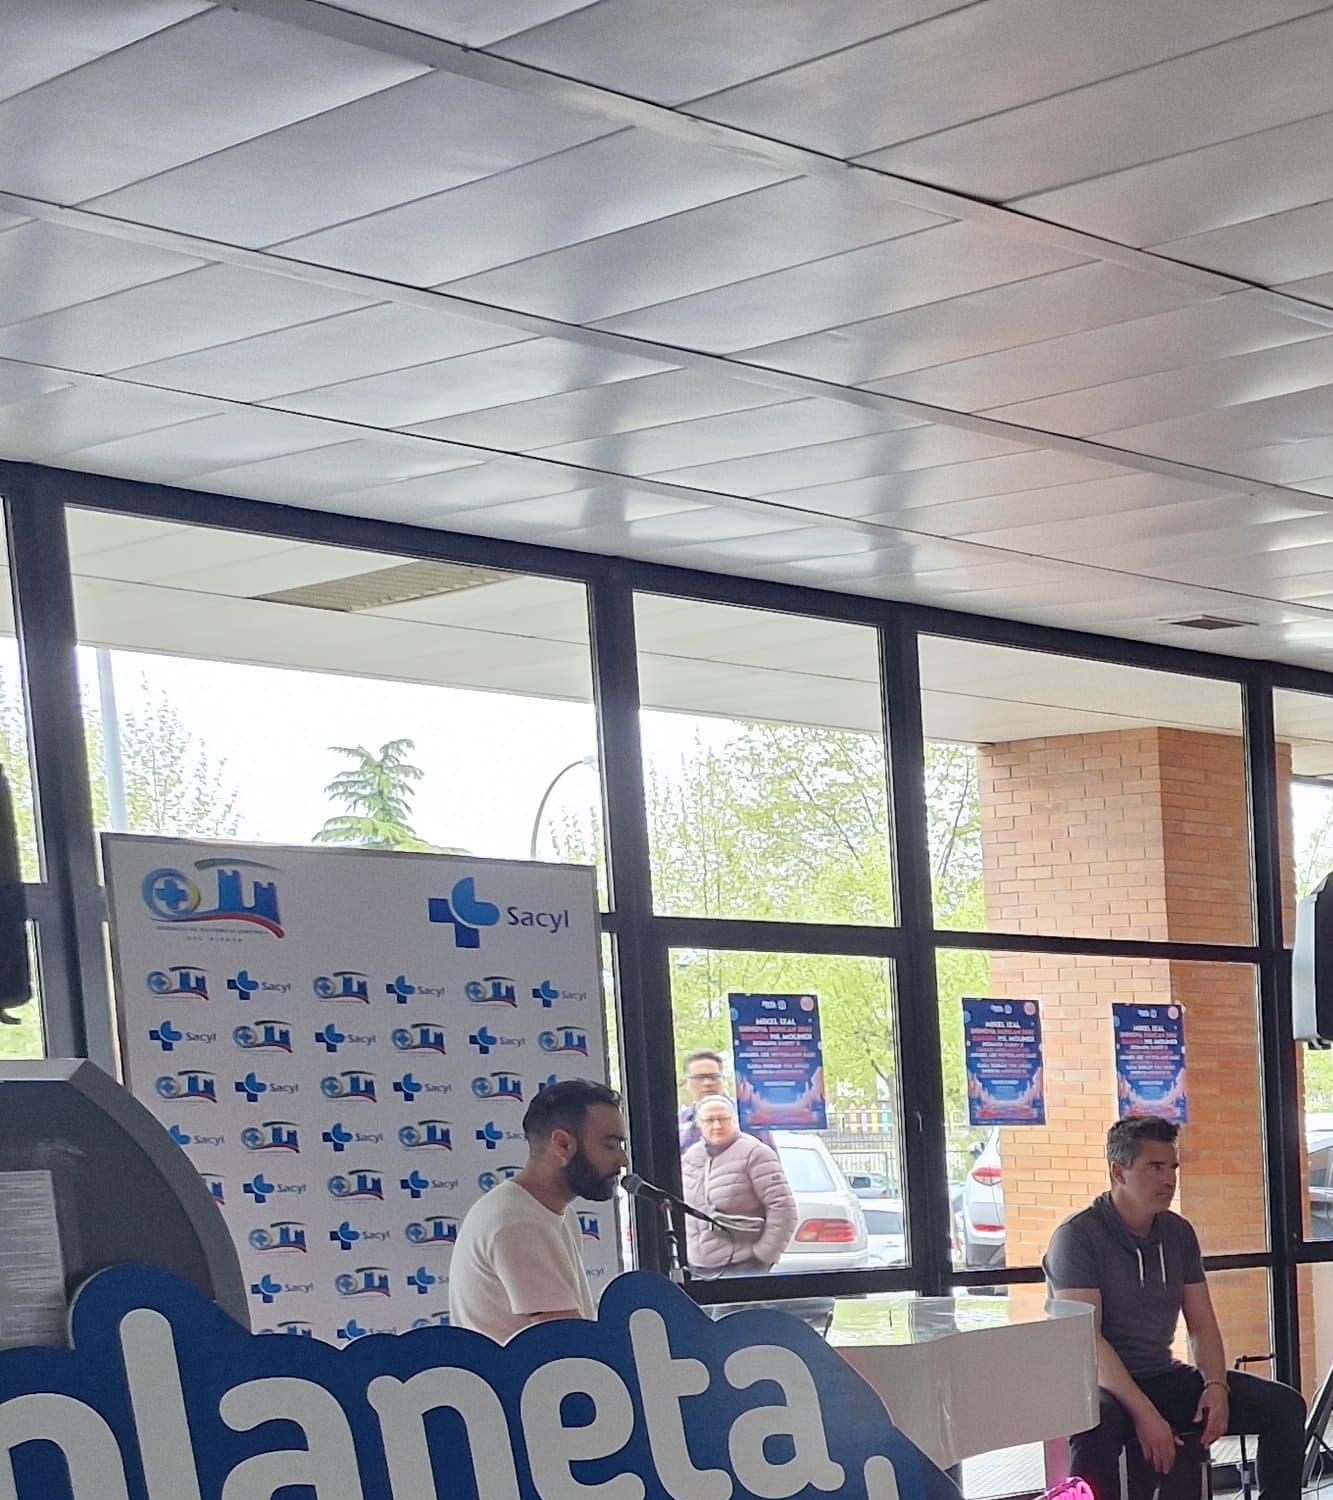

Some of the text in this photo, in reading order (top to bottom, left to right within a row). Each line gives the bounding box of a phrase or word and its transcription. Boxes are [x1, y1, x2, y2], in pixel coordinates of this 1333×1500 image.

[506, 906, 569, 933] Sacyl
[261, 981, 291, 991] Sacyl
[417, 985, 445, 997] Sacyl
[561, 990, 587, 1001] Sacyl
[185, 1031, 216, 1044] Sacyl
[348, 1033, 376, 1044] Sacyl
[499, 1036, 526, 1048] Sacyl
[269, 1082, 299, 1094] Sacyl
[424, 1082, 452, 1095] Sacyl
[194, 1135, 225, 1147] Sacyl
[355, 1132, 383, 1143] Sacyl
[277, 1183, 306, 1195] Sacyl
[432, 1178, 459, 1190] Sacyl
[362, 1229, 390, 1242] Sacyl
[284, 1282, 314, 1294] Sacyl
